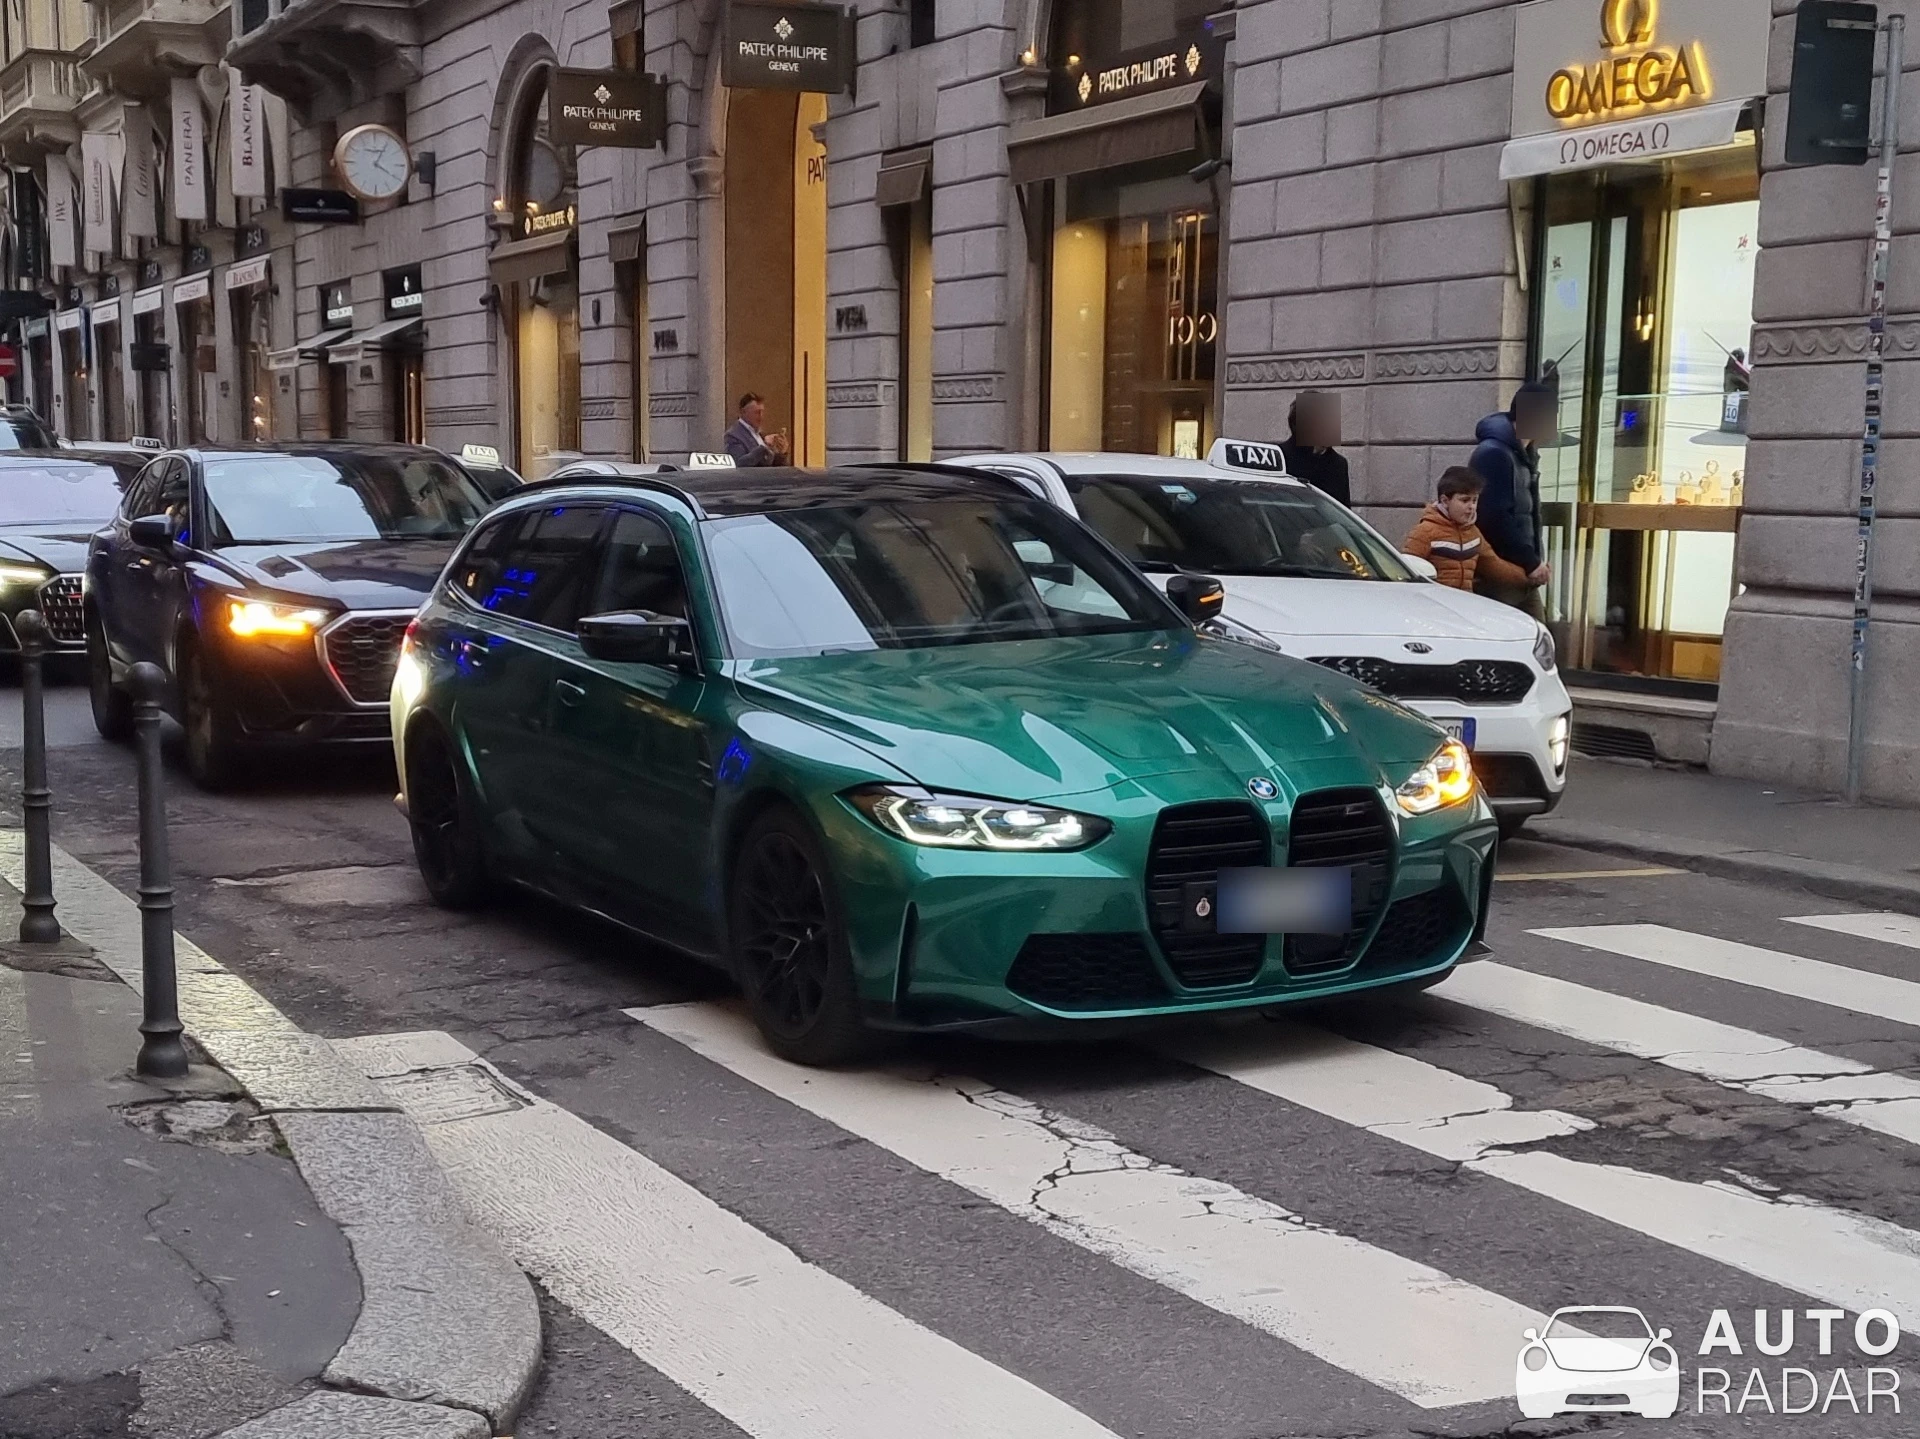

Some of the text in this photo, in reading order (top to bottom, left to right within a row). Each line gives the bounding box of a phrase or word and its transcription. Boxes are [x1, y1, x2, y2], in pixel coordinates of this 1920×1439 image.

[739, 41, 828, 61] PATEK PHILIPPE
[1099, 54, 1177, 93] PATEK PHILIPPE
[1546, 44, 1703, 118] OMEGA
[563, 105, 642, 121] PATEK PHILIPPE
[183, 110, 194, 186] PANERAI
[1583, 131, 1646, 159] OMEGA
[469, 446, 496, 458] TAXI
[697, 453, 732, 466] TAXI
[1231, 445, 1278, 468] TAXI
[1409, 642, 1431, 653] KIA
